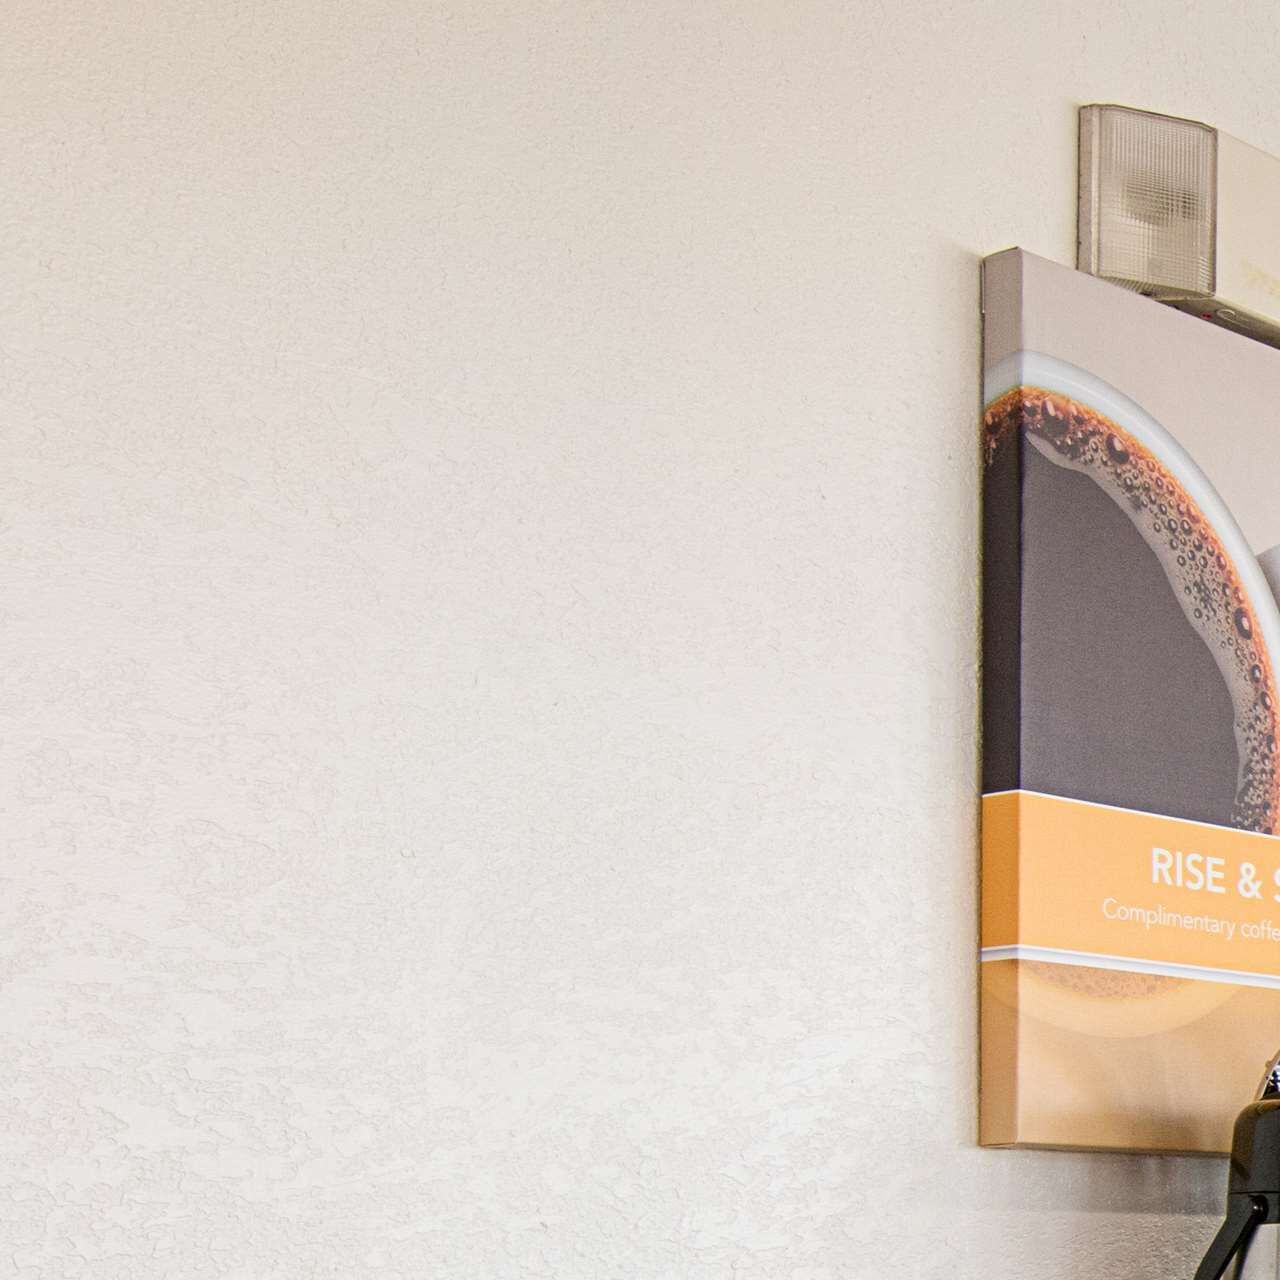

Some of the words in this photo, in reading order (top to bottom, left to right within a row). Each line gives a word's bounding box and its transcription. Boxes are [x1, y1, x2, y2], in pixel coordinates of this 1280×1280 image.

[1151, 848, 1226, 894] RISE
[1237, 862, 1263, 900] &
[1102, 897, 1236, 940] Complimentary
